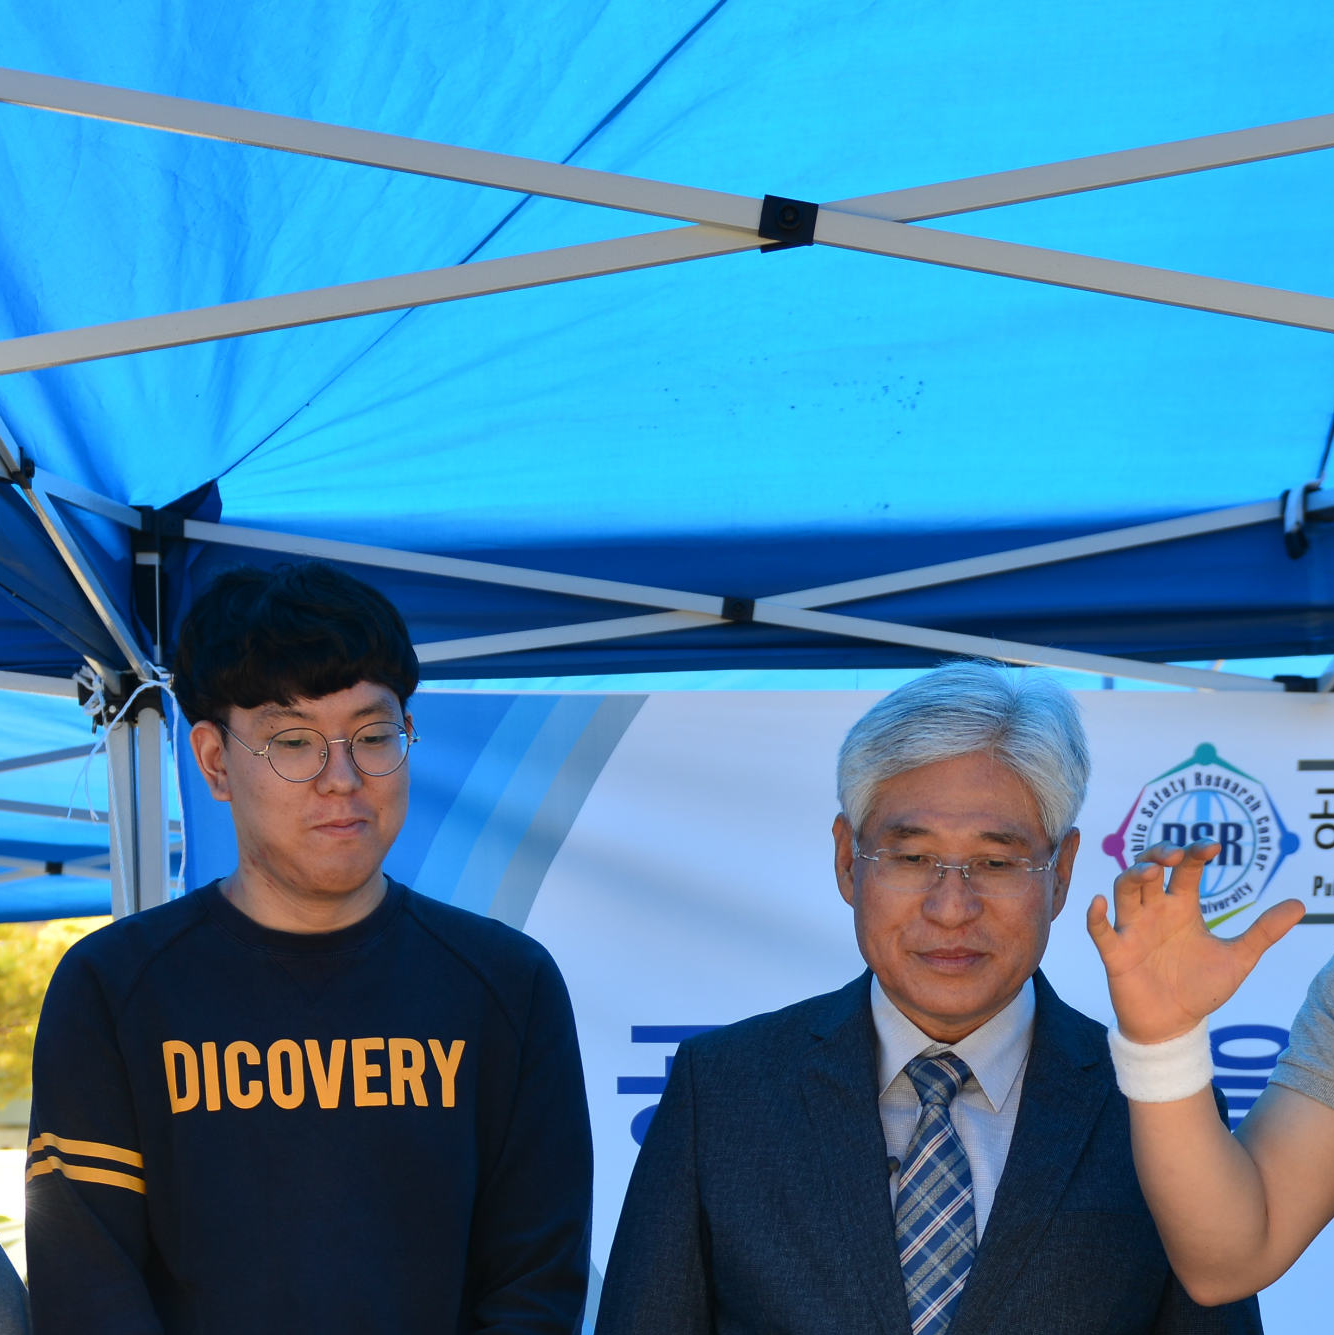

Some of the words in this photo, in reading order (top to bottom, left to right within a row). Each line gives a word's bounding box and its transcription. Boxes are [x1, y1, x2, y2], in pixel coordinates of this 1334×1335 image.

[1141, 776, 1187, 818] Safety
[1194, 772, 1262, 813] Research
[1256, 815, 1272, 871] Center
[162, 1037, 466, 1114] DICOVERY
